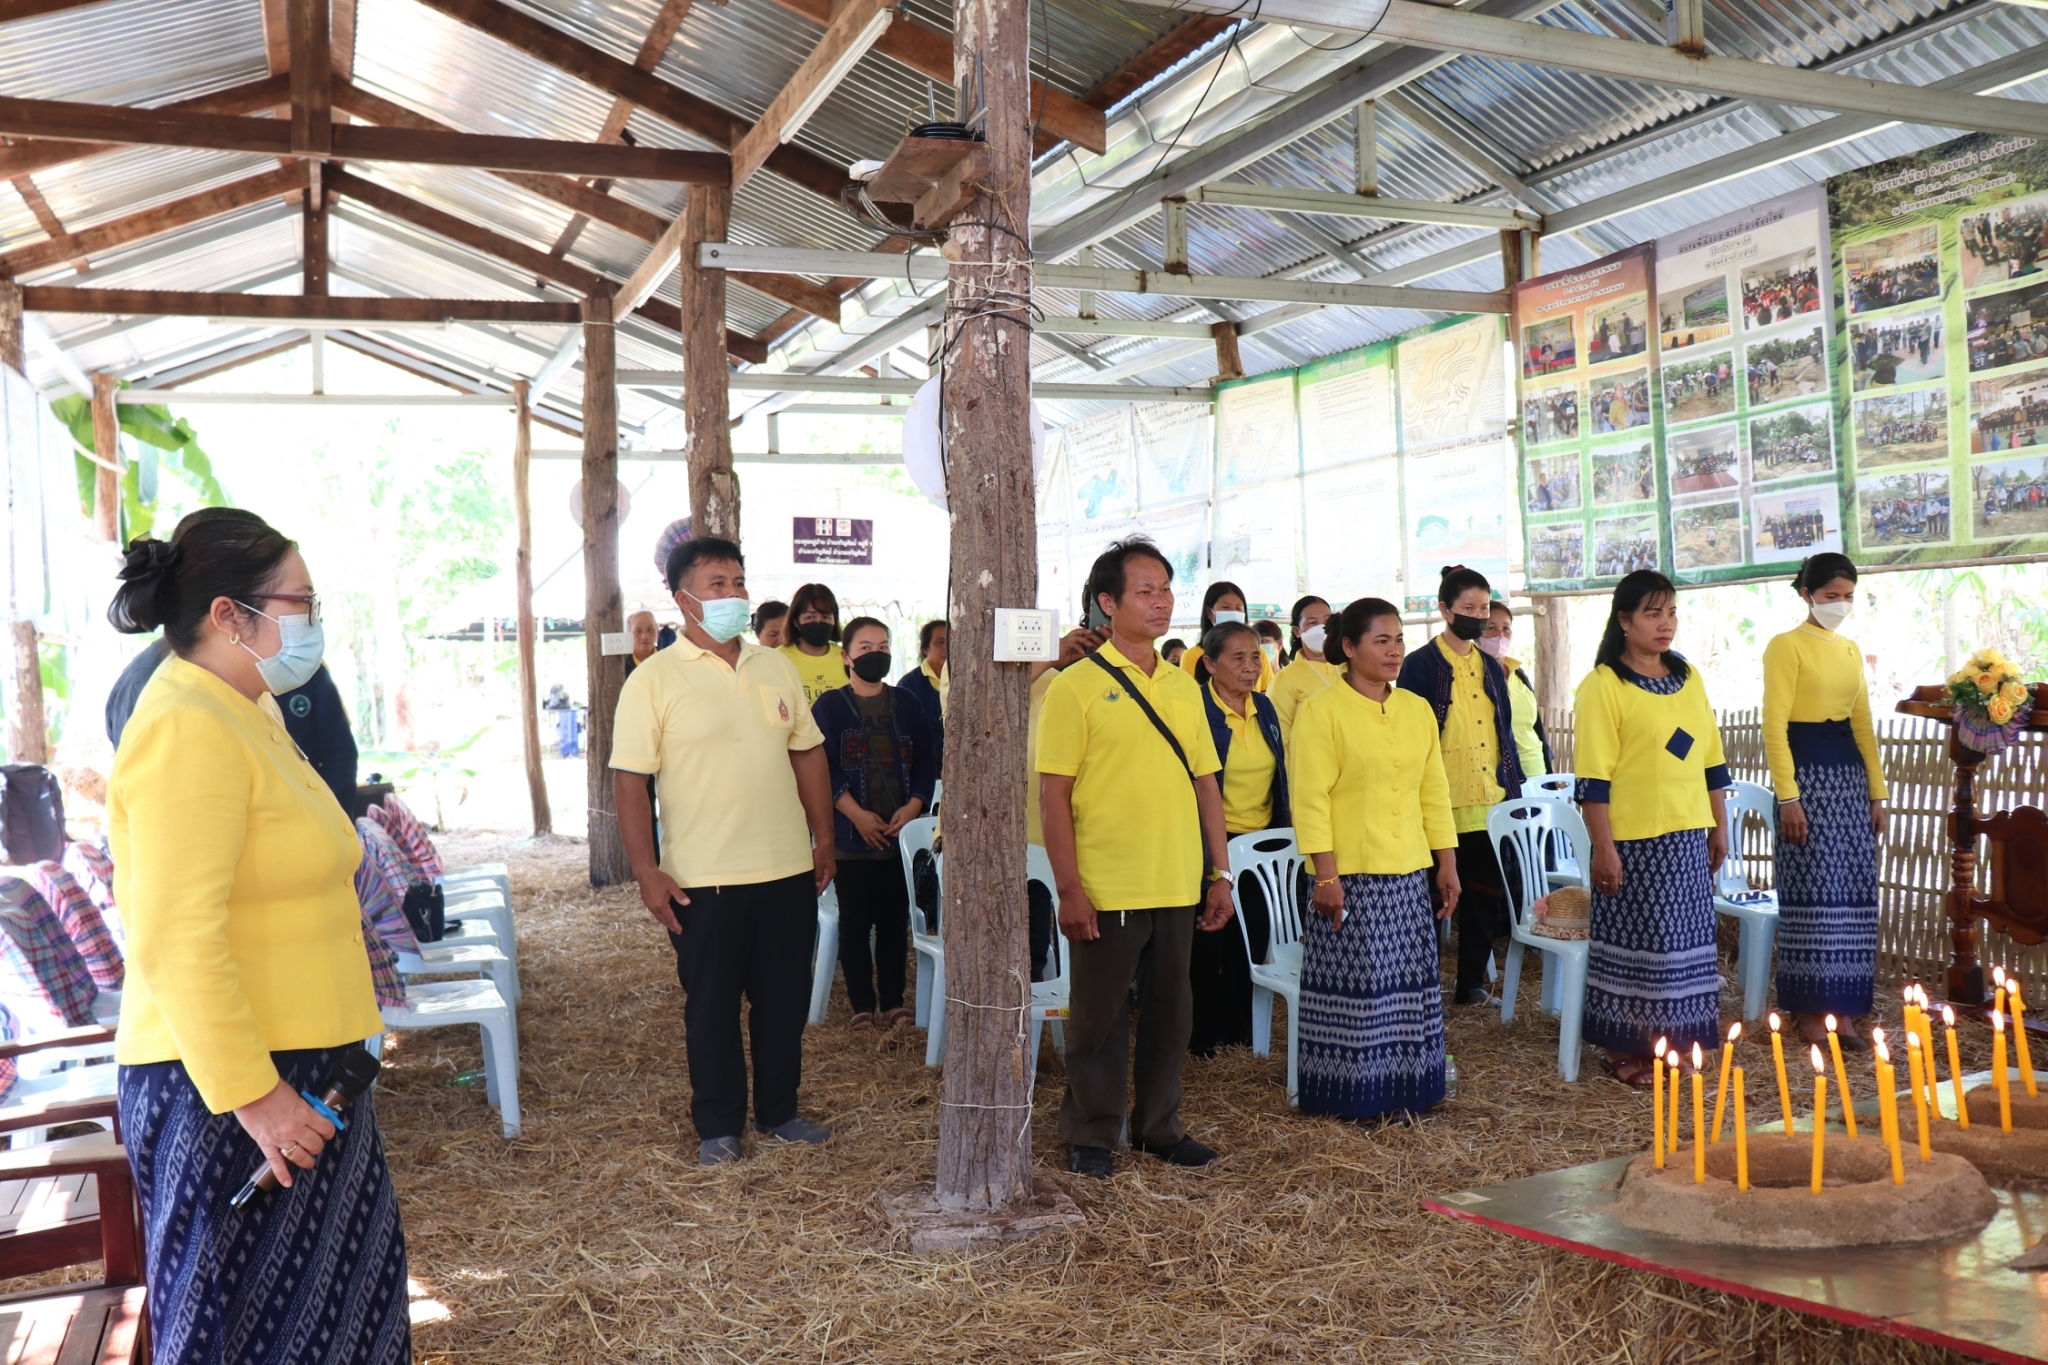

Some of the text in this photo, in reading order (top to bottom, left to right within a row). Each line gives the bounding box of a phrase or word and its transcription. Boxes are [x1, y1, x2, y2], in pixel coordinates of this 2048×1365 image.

[1873, 168, 1927, 193] อบรมพี่น้อง
